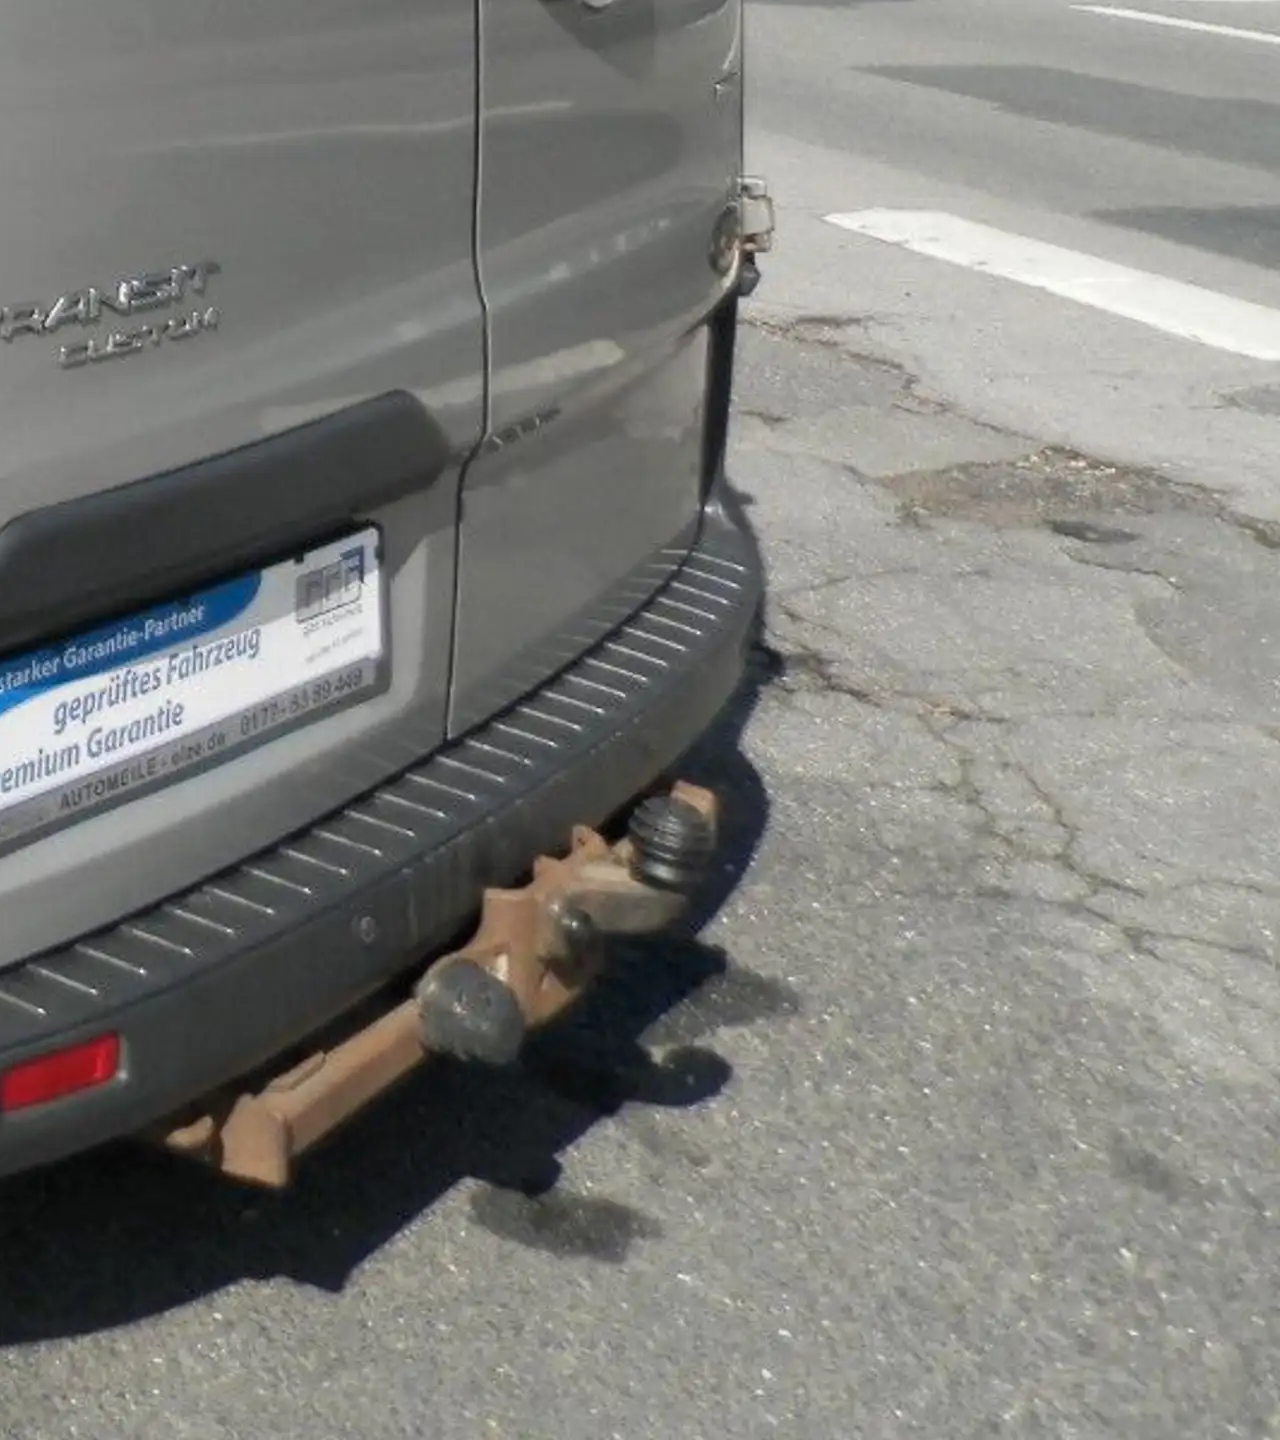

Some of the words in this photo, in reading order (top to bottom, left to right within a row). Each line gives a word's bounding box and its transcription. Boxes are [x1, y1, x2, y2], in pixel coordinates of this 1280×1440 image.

[58, 307, 219, 370] CUSTOM
[63, 603, 206, 670] Garantie-Partner
[53, 666, 162, 735] geprüftes
[166, 628, 262, 686] Fahrzeug
[86, 699, 184, 760] Garantie
